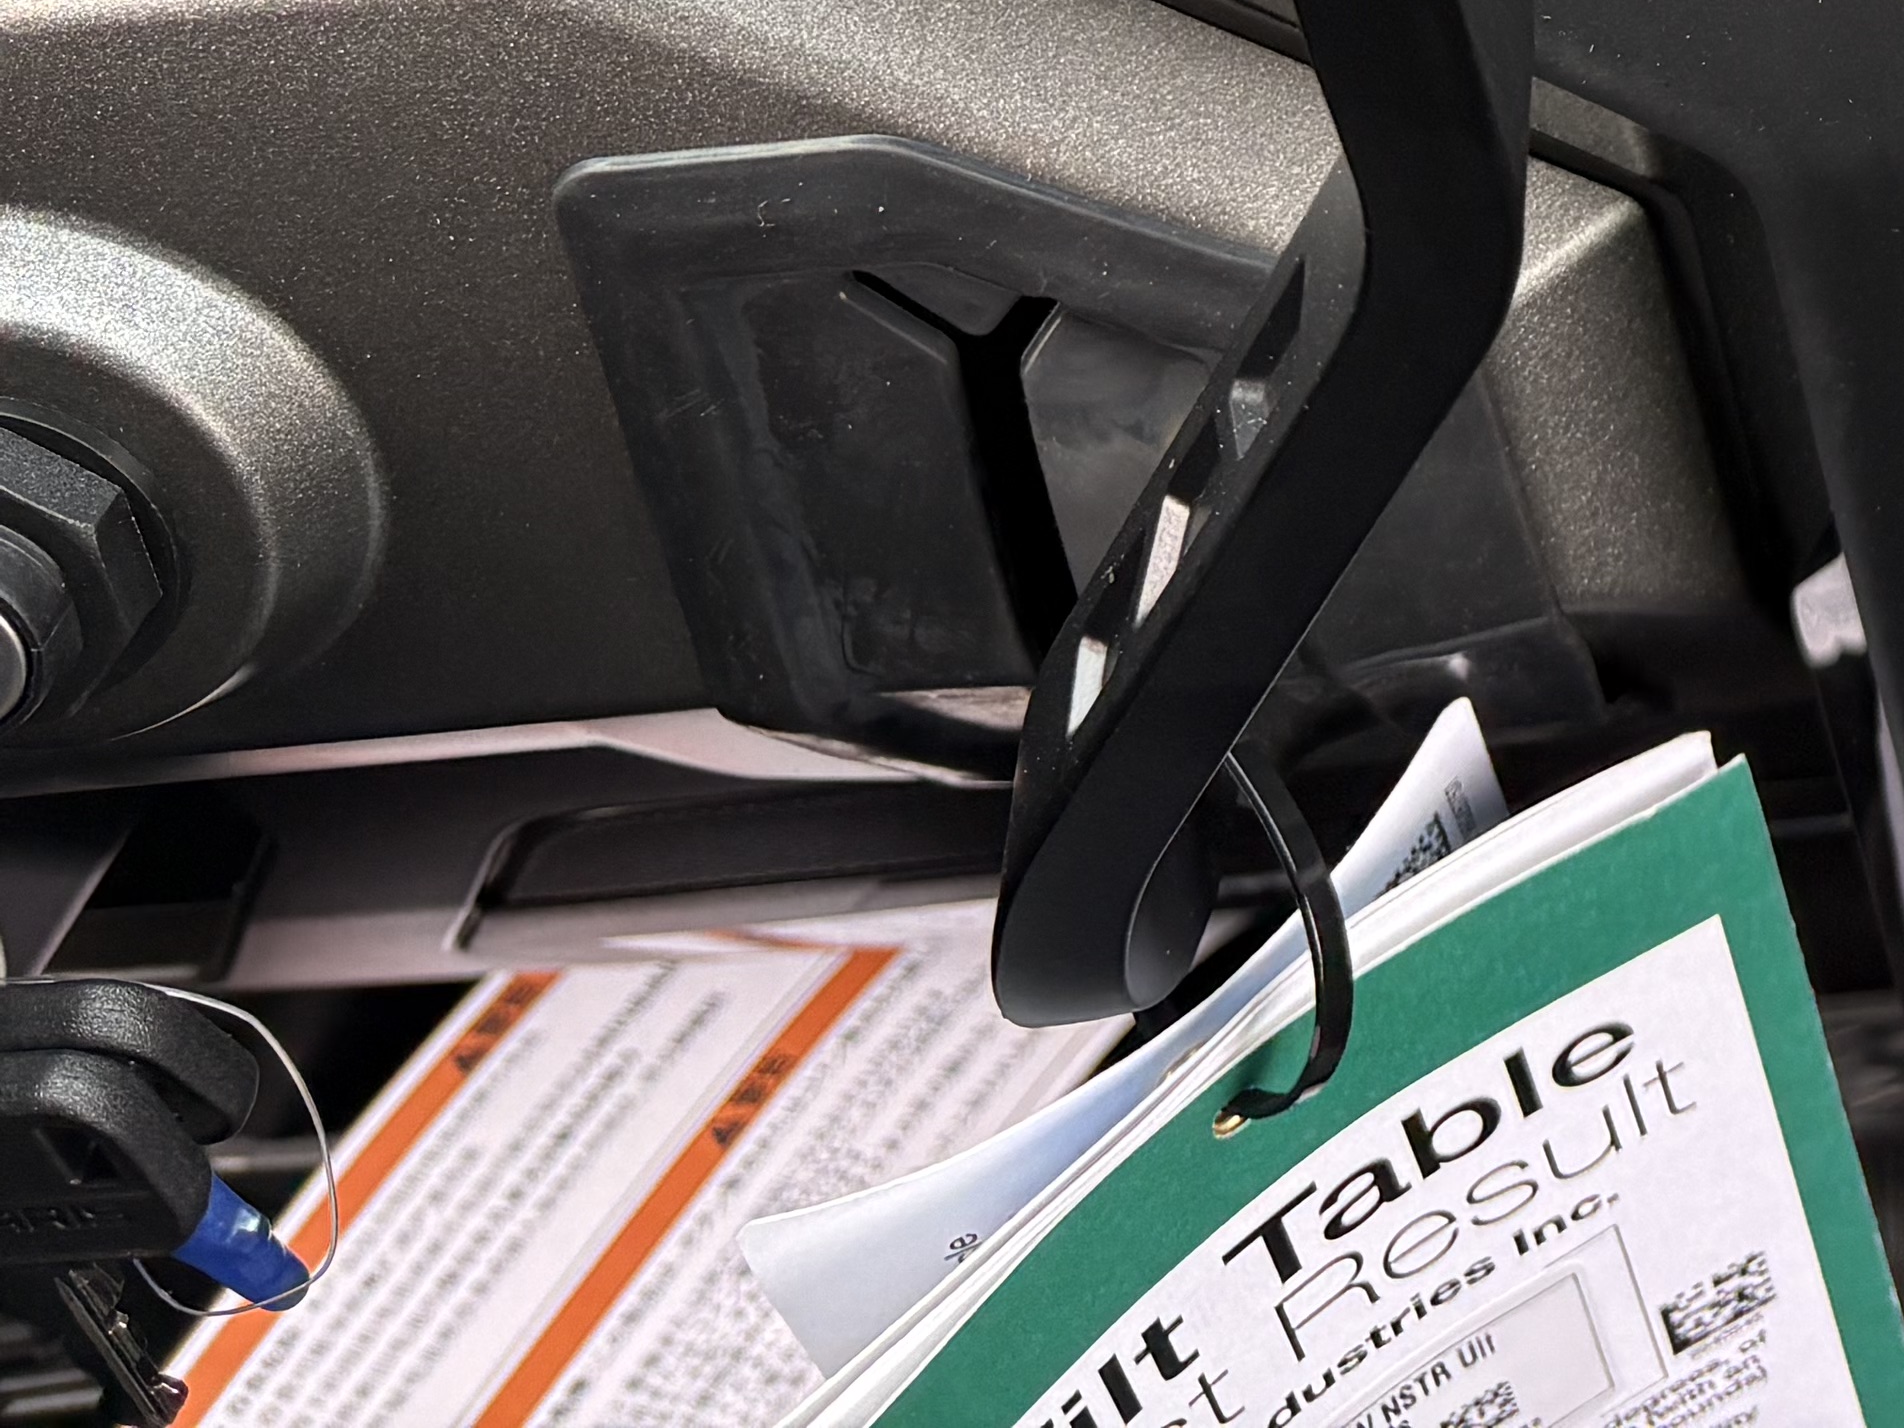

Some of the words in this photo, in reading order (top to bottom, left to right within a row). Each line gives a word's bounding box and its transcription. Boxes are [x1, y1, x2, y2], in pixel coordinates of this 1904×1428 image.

[1040, 1315, 1200, 1428] ilt
[1220, 1020, 1636, 1285] Table
[1266, 1255, 1497, 1428] dustries
[1512, 1191, 1620, 1257] Inc.
[1273, 1058, 1698, 1363] Result
